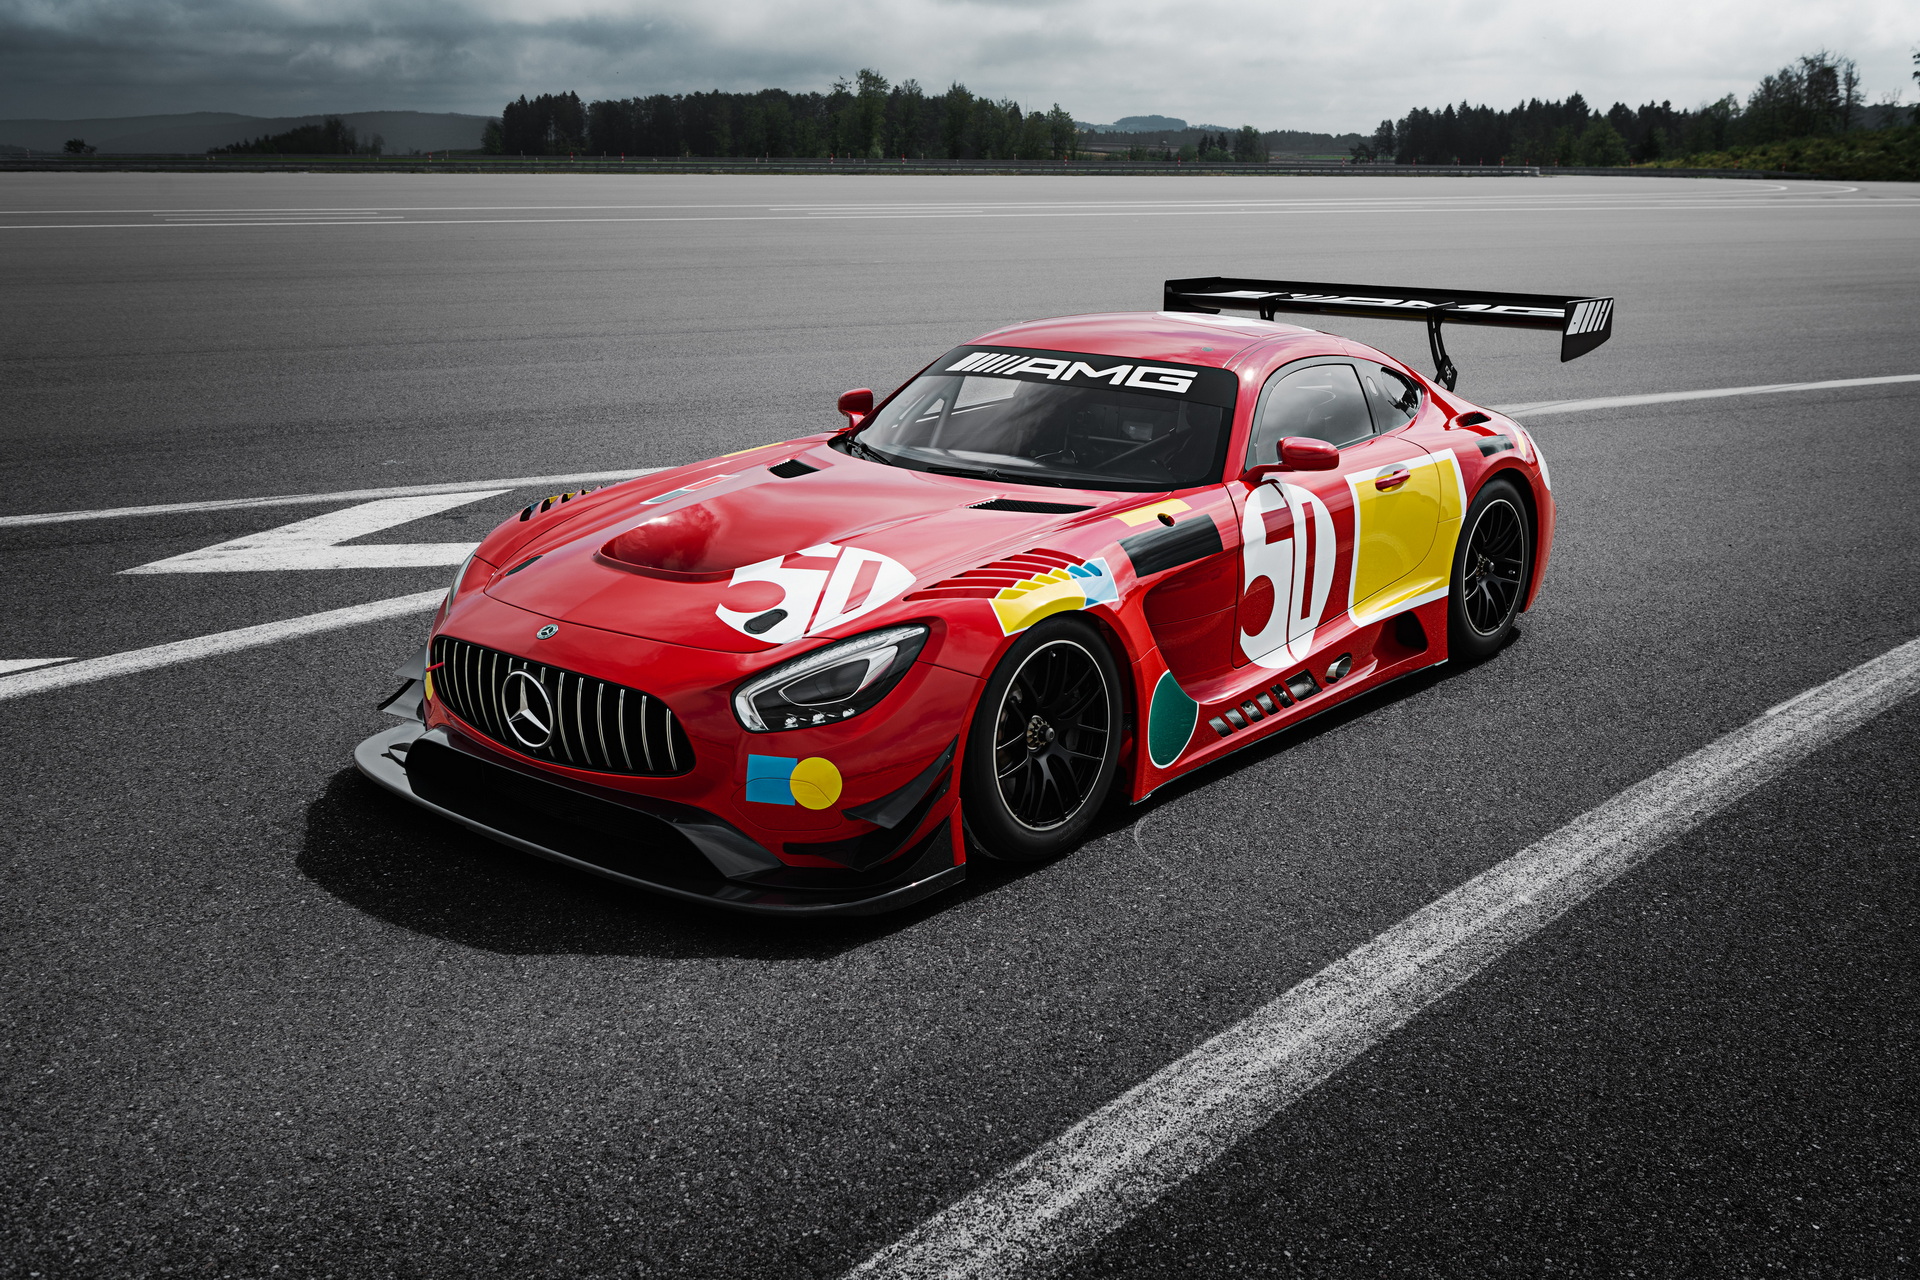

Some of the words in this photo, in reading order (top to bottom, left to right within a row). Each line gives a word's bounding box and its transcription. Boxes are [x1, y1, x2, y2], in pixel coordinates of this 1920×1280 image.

[1003, 357, 1198, 394] AMG
[715, 542, 917, 644] 50
[1239, 482, 1337, 669] 50
